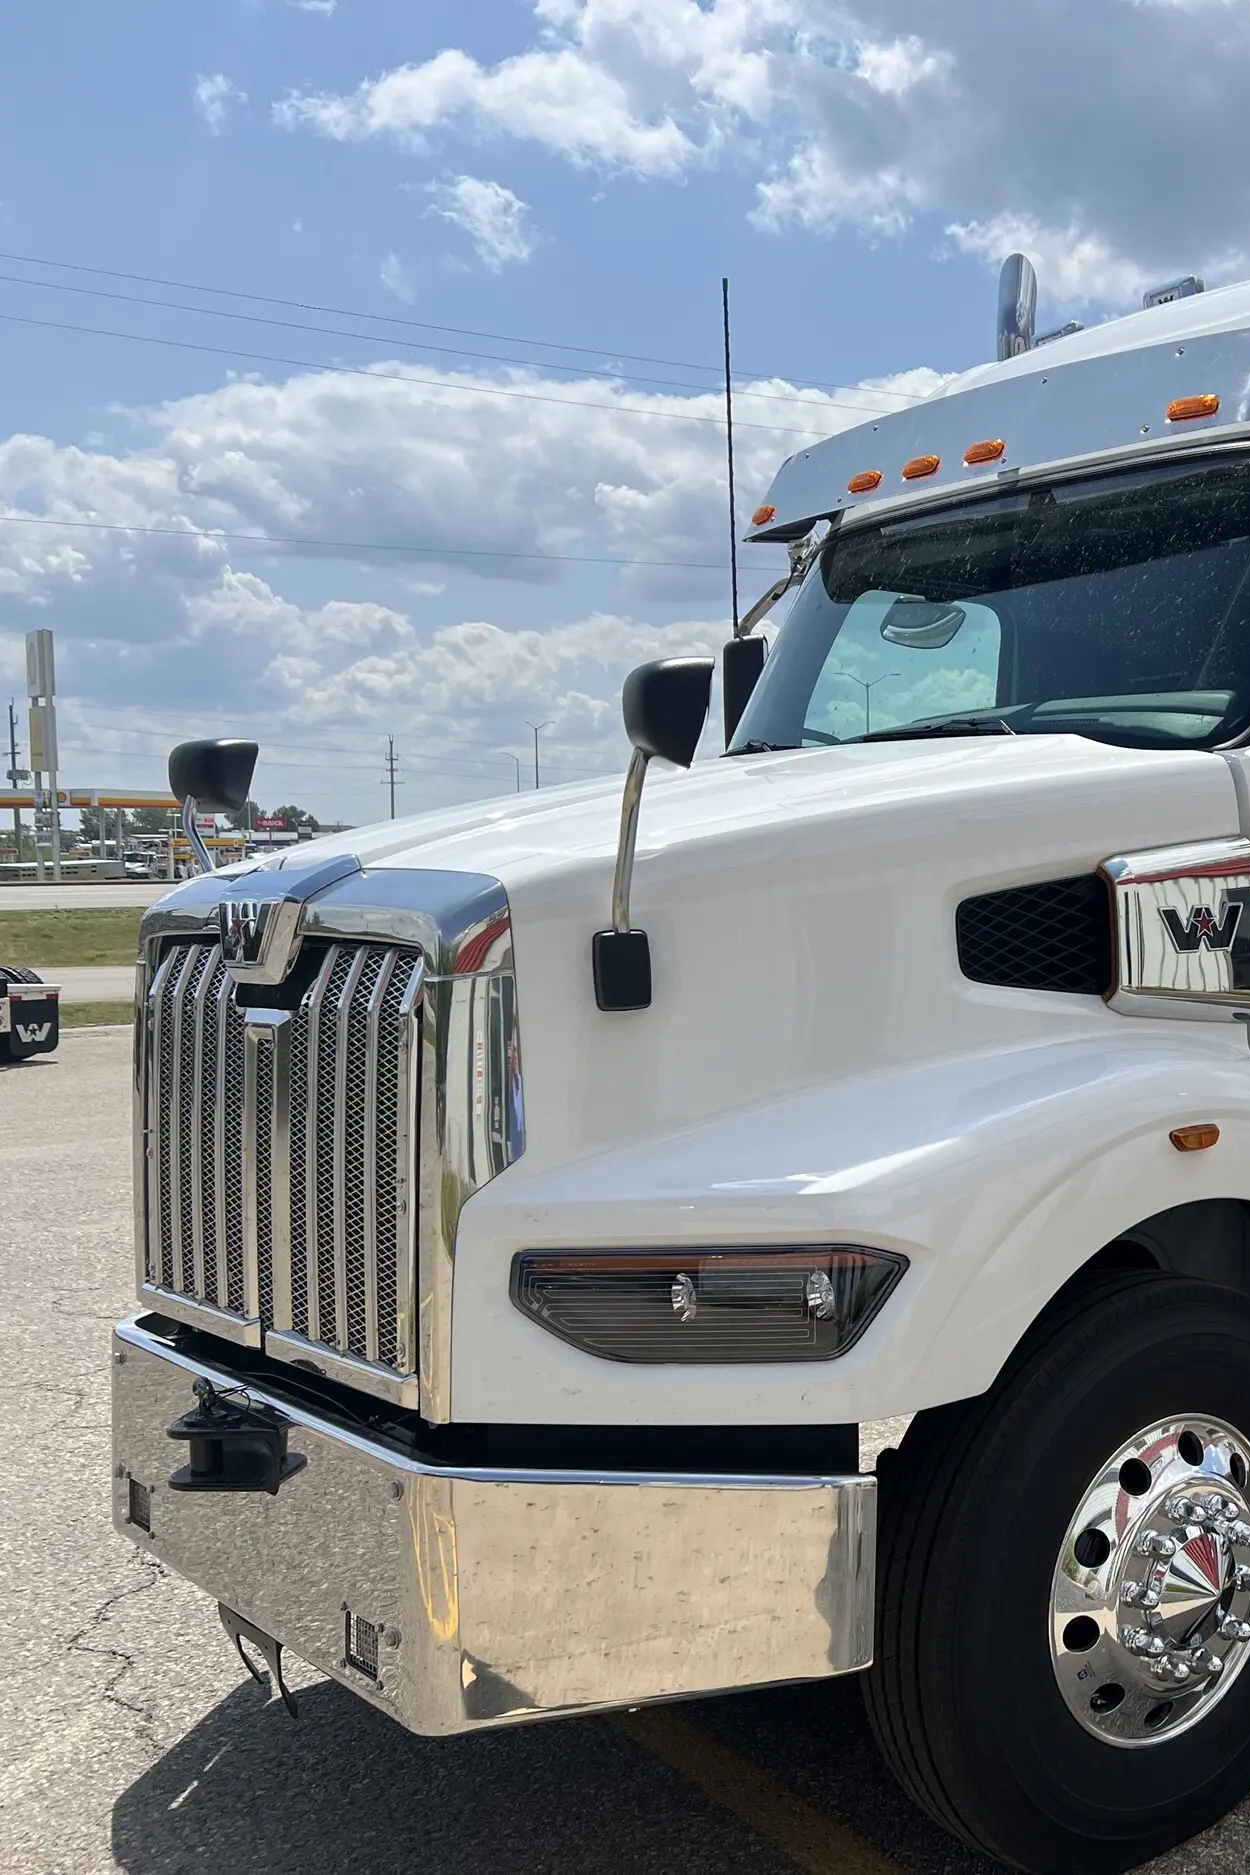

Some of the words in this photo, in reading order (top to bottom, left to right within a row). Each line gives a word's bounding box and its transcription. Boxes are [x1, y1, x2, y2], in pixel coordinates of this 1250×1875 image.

[219, 902, 274, 966] W
[1157, 901, 1244, 954] W
[15, 1022, 52, 1043] W
